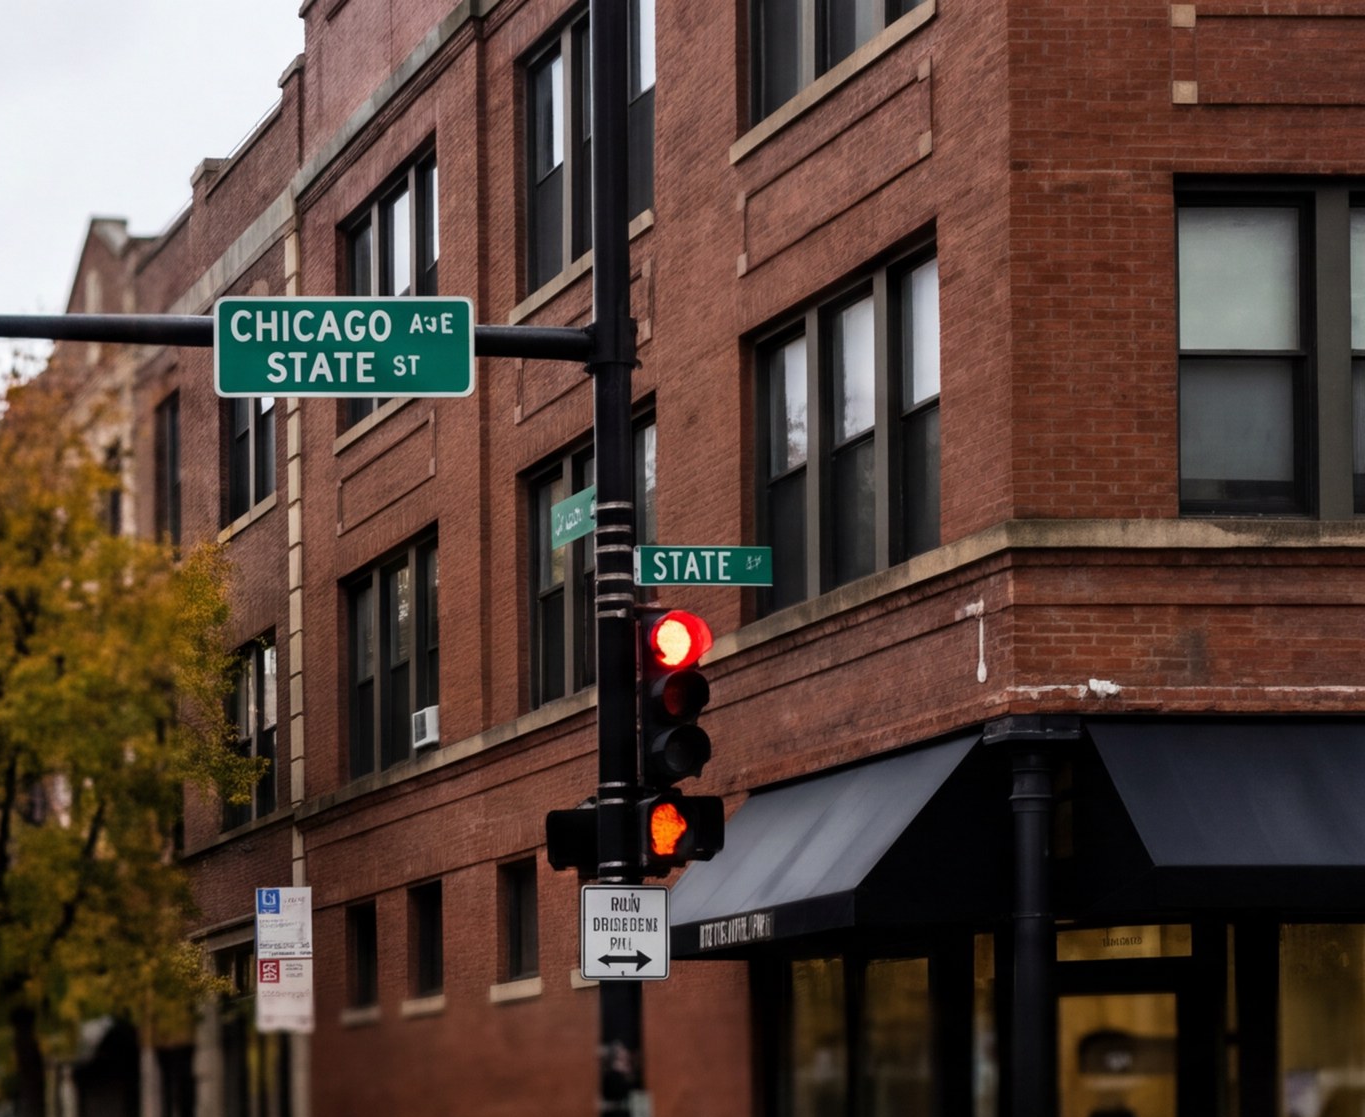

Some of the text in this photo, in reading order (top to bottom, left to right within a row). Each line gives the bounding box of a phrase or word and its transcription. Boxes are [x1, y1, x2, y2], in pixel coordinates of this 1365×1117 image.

[230, 309, 392, 342] CHICAGO
[266, 352, 420, 383] STATE ST
[653, 551, 731, 581] STATE
